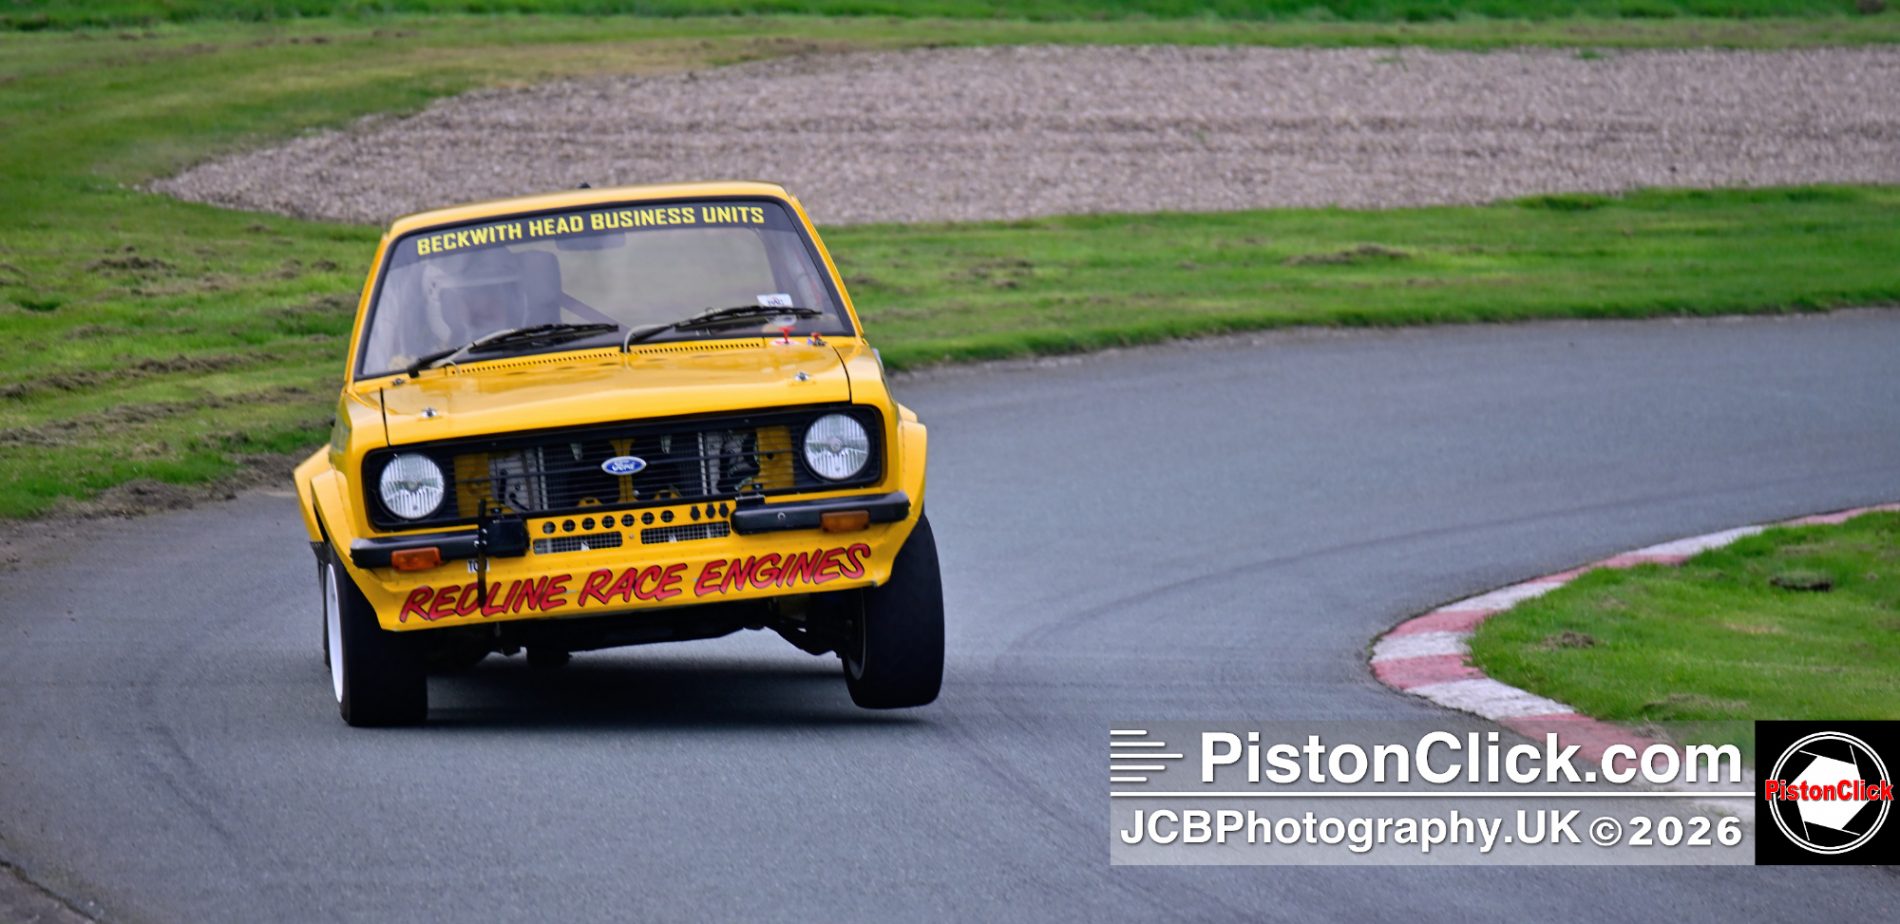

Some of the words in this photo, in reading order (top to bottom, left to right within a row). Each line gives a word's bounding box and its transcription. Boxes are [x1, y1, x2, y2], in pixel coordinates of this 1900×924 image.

[416, 222, 522, 256] BECKWITH
[528, 215, 584, 238] HEAD
[590, 207, 696, 231] BUSINESS
[702, 206, 765, 224] UNITS
[399, 574, 572, 623] REDLINE
[577, 563, 688, 608] RACE
[694, 543, 871, 597] ENGINES
